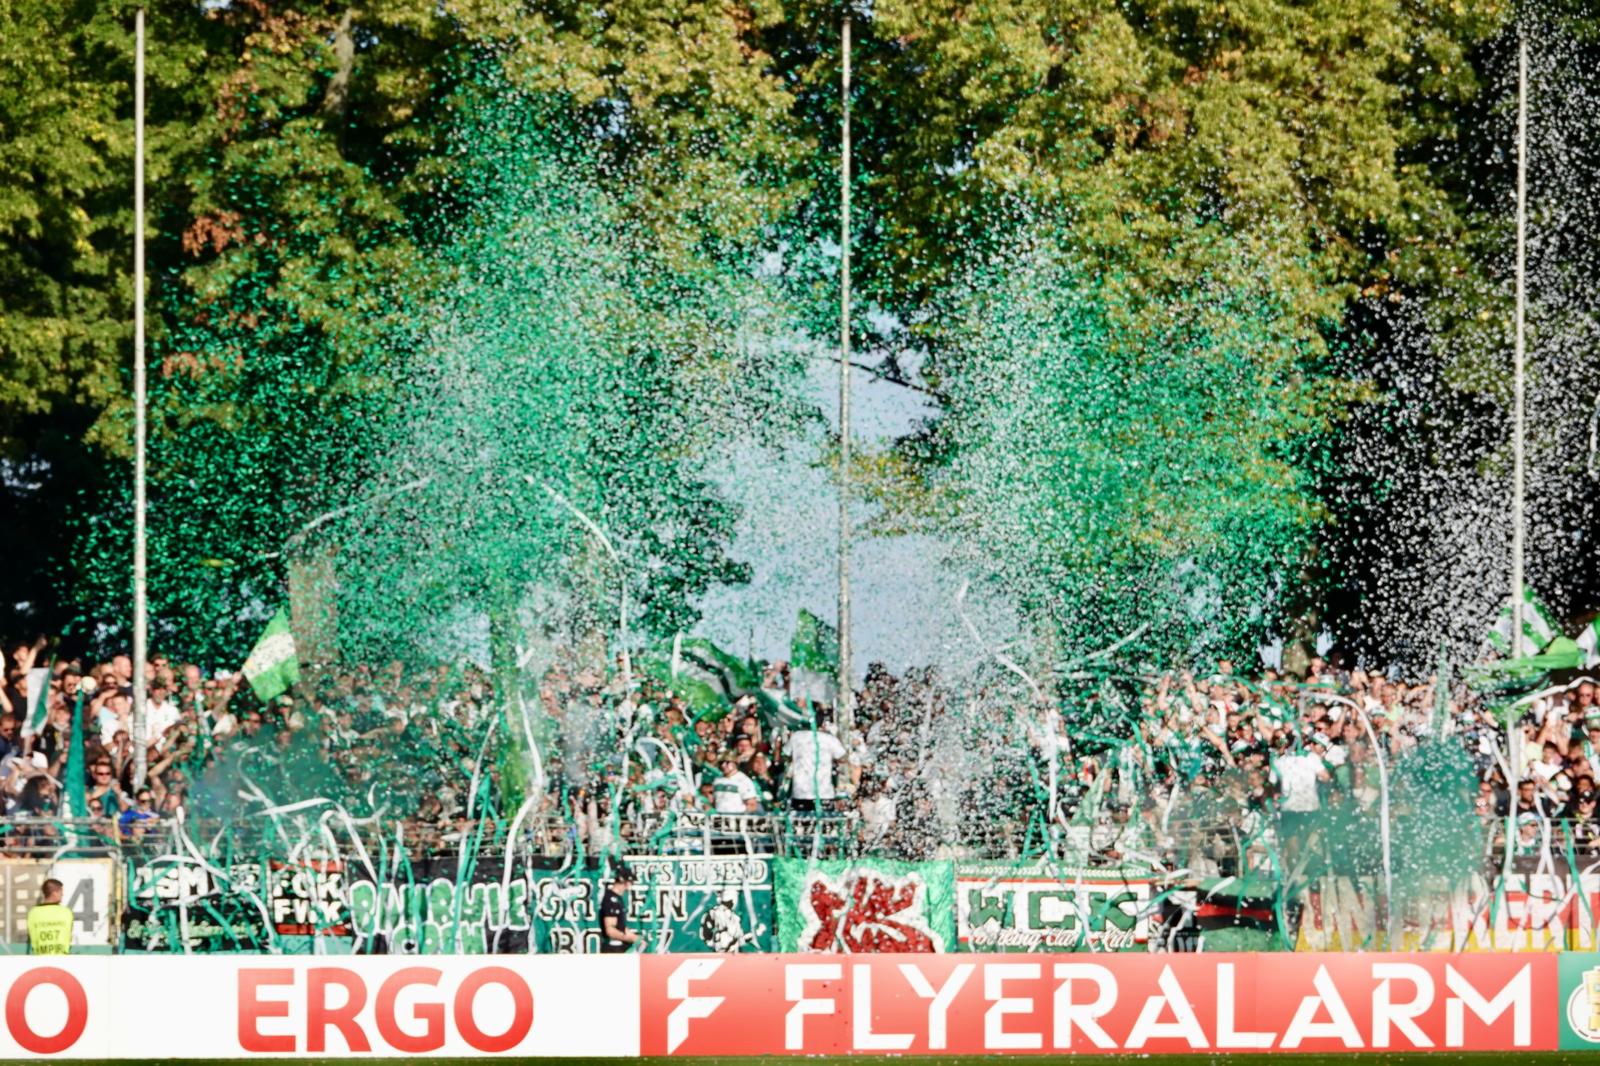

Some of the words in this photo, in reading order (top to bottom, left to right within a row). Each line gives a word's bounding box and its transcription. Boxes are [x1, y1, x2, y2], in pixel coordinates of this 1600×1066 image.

[39, 930, 60, 941] 067
[67, 879, 99, 932] 4
[968, 890, 1138, 931] WCK
[5, 966, 88, 1054] O
[237, 967, 534, 1053] ERGO
[785, 963, 1531, 1049] FLYERALARM
